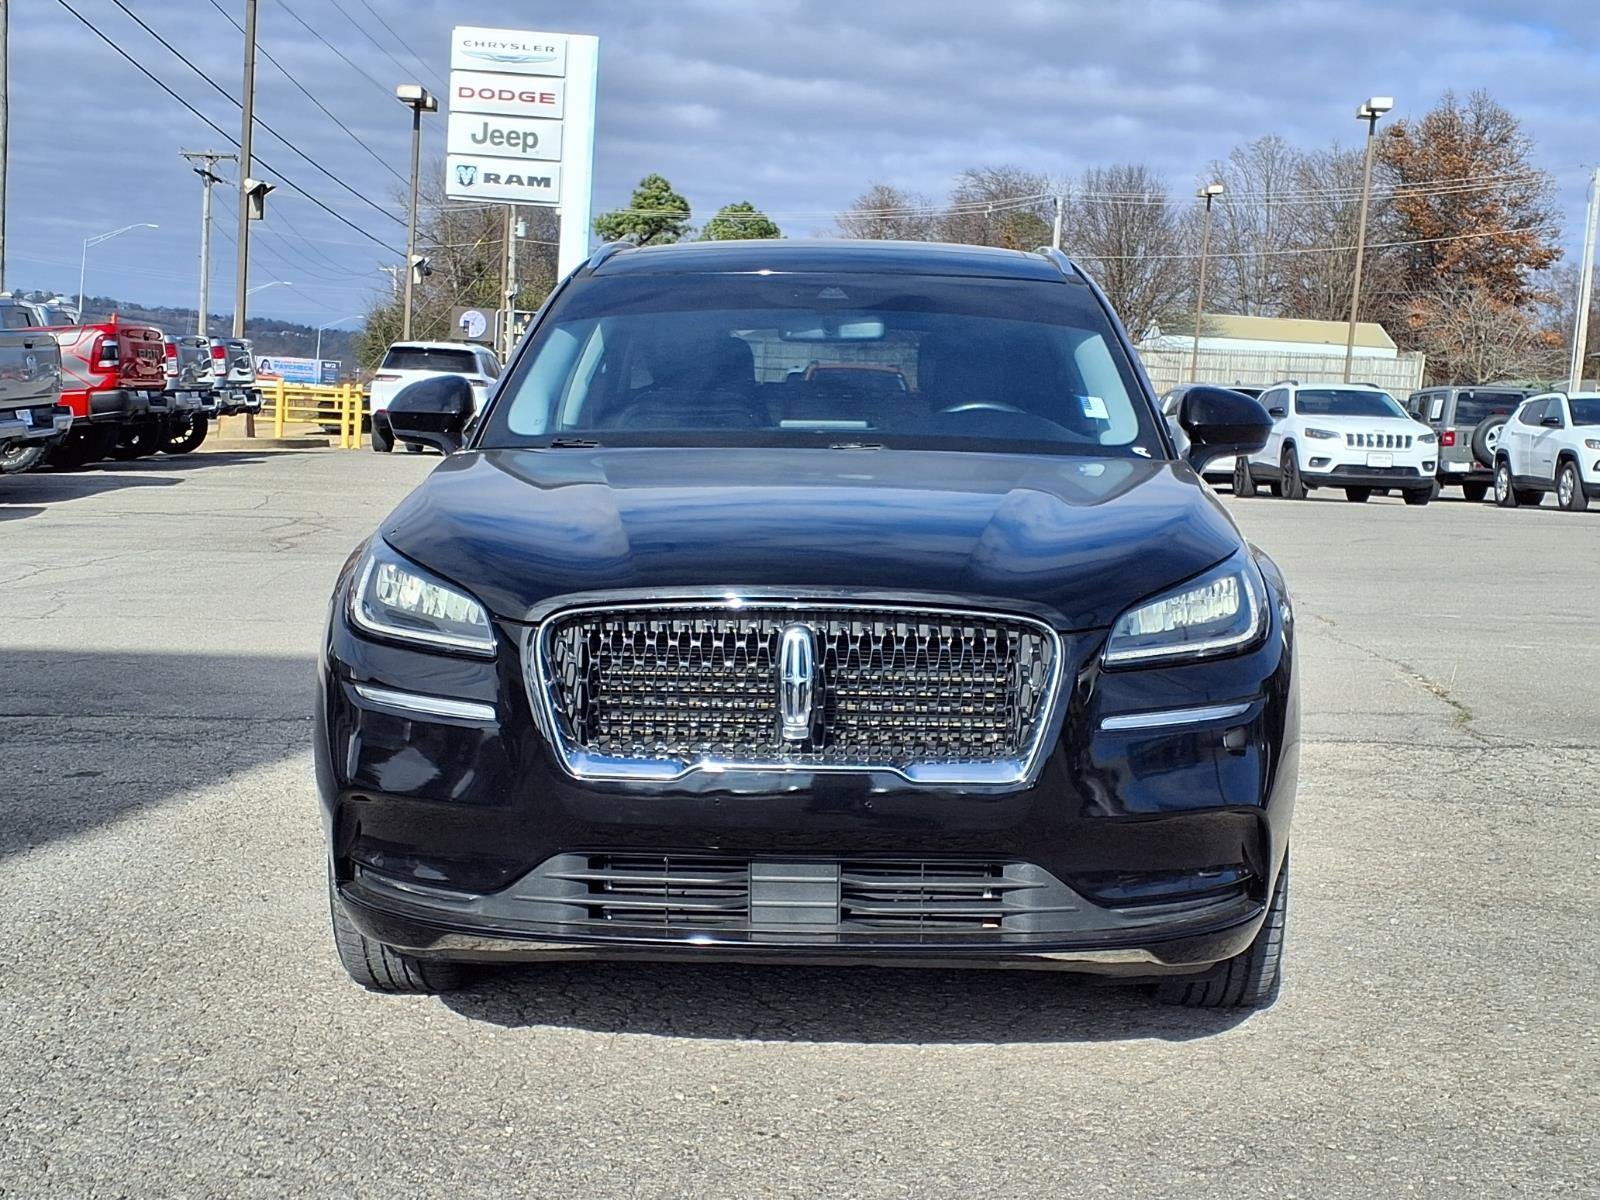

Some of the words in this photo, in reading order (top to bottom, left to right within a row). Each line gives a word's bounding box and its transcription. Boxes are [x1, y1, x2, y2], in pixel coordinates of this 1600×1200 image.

[463, 40, 555, 53] CHRYSLER
[458, 86, 556, 105] DODGE
[471, 122, 539, 153] Jeep
[483, 172, 552, 188] RAM
